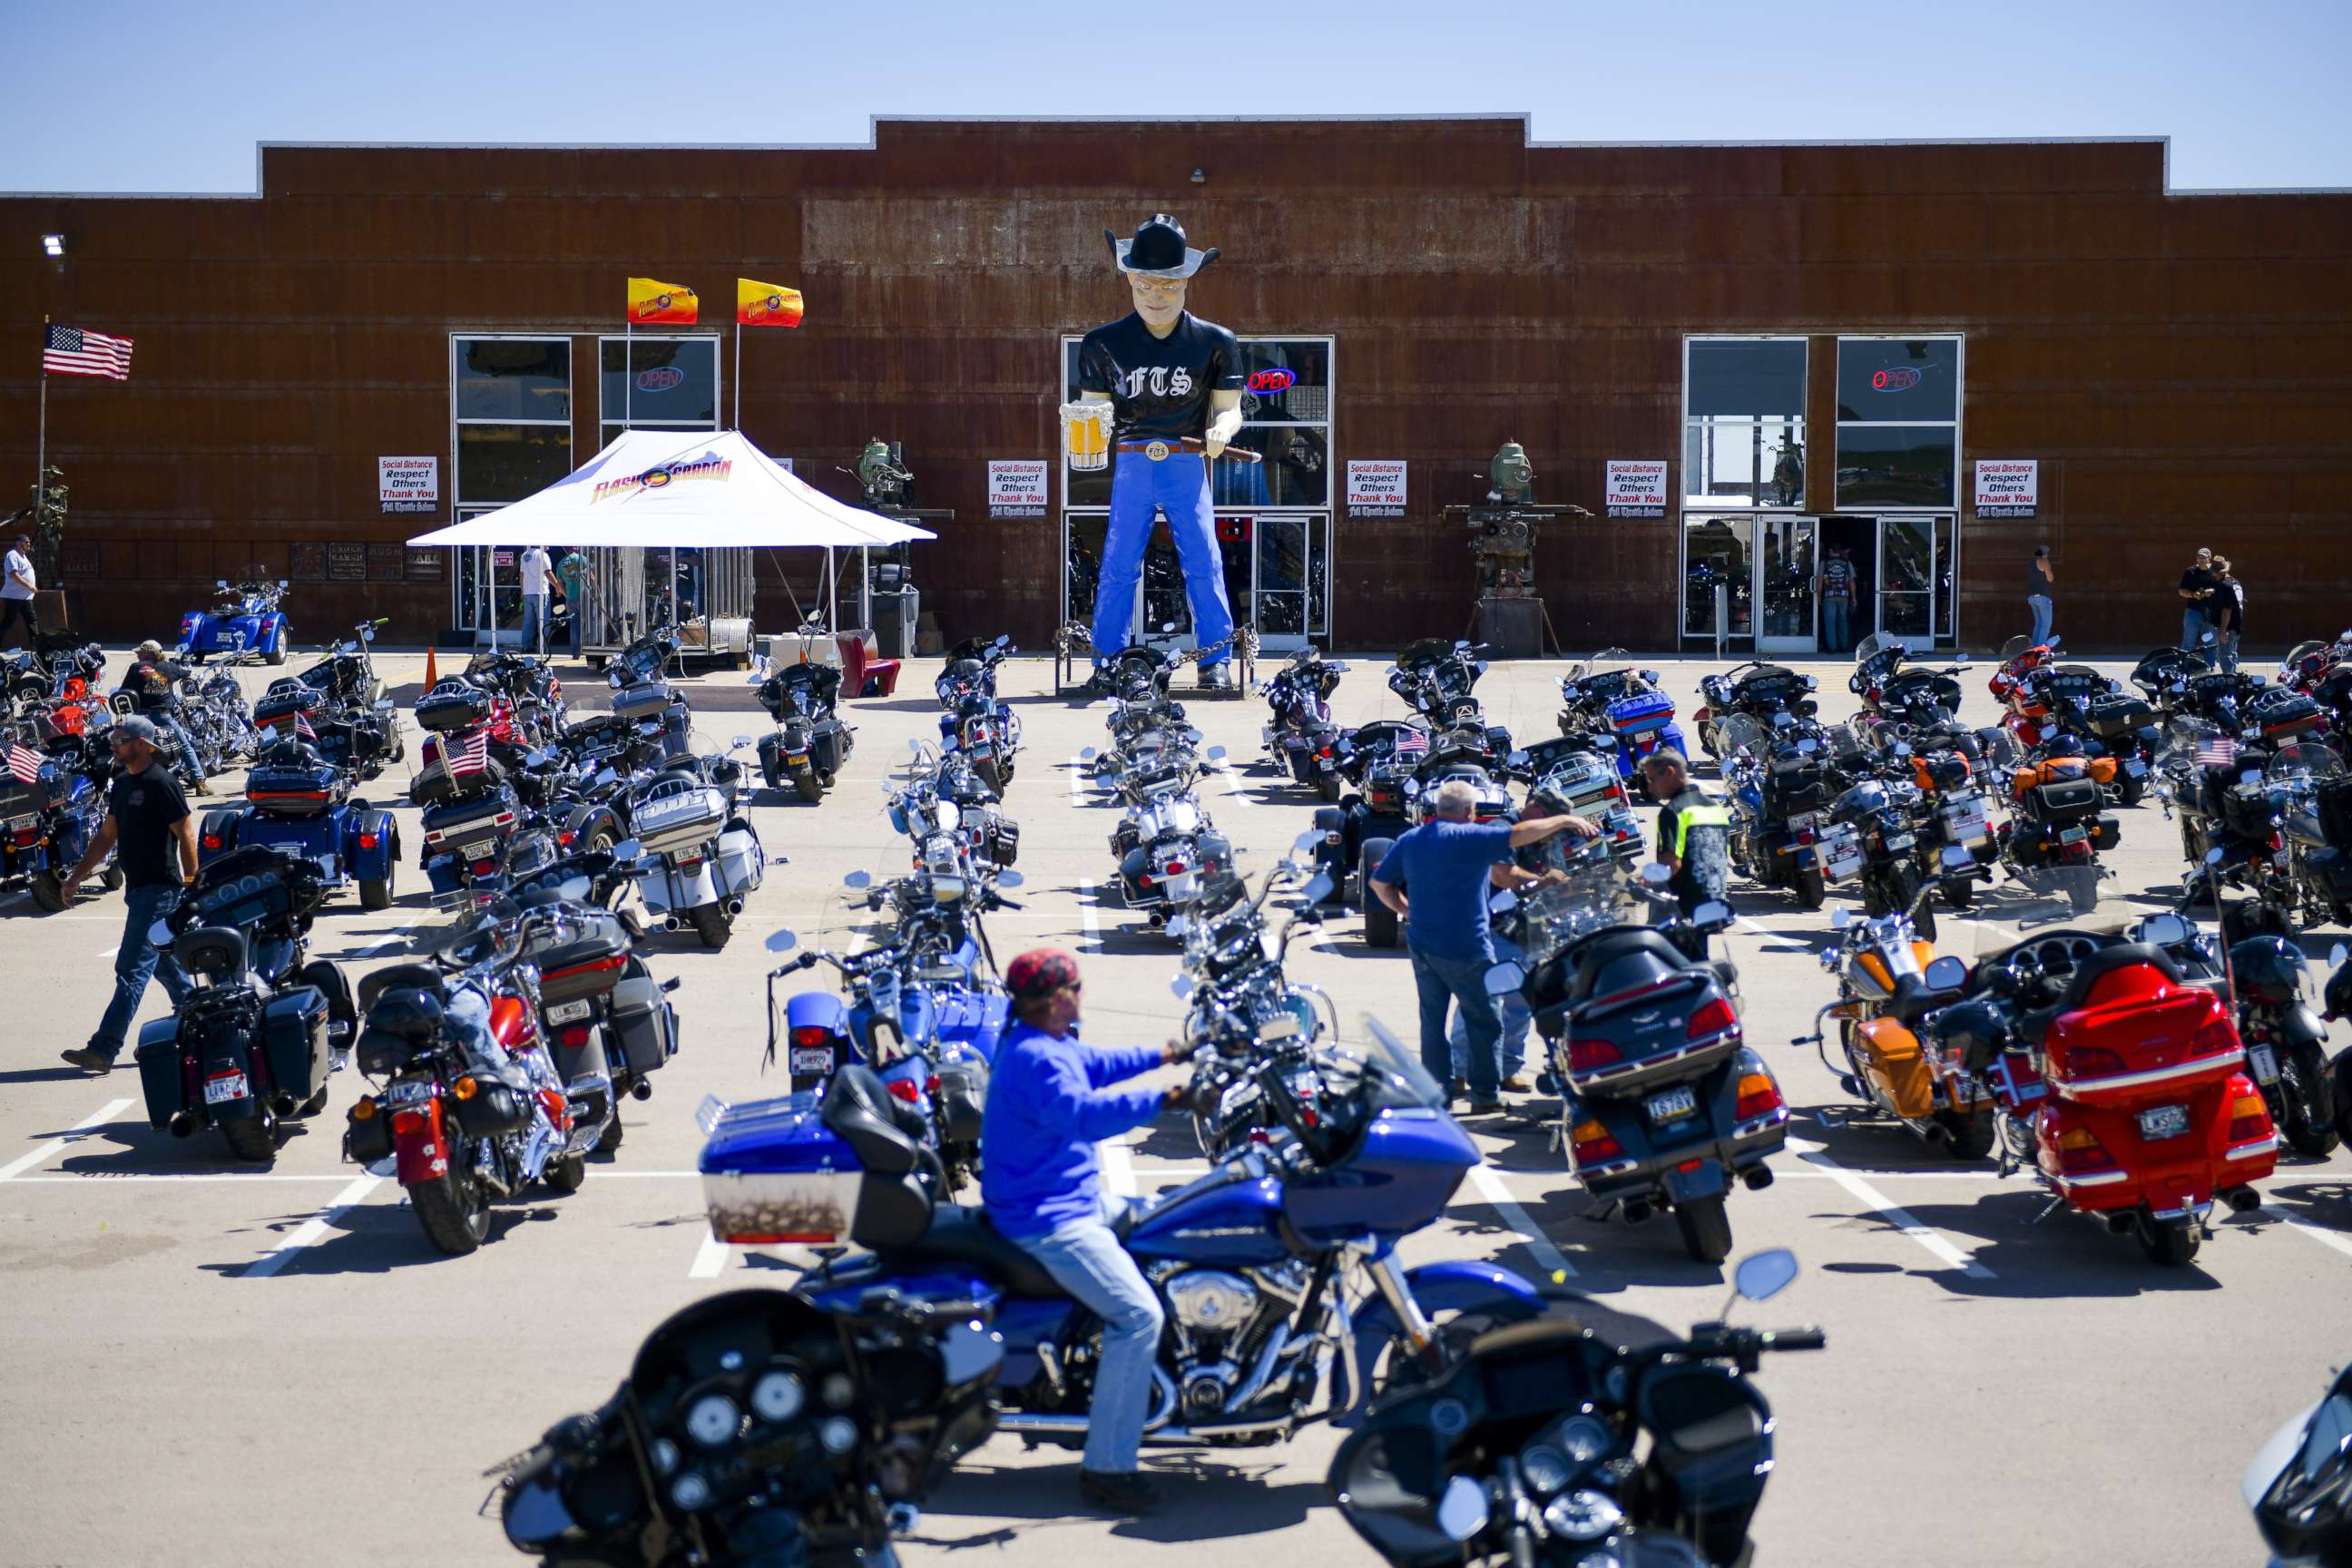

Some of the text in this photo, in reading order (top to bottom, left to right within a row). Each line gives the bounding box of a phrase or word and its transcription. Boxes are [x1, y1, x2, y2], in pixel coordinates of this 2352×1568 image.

[638, 370, 679, 388] OPEN
[1126, 366, 1192, 399] FTS
[1249, 370, 1292, 390] OPEN
[1872, 369, 1917, 389] OPEN
[383, 460, 433, 469] Social Distance
[992, 464, 1043, 472] Social Distance
[1351, 464, 1402, 472] Social Distance
[1610, 464, 1663, 472] Social Distance
[1980, 464, 2033, 472] Social Distance
[387, 470, 429, 480] Respect
[995, 474, 1039, 483] Respect
[1355, 474, 1398, 483] Respect
[1614, 474, 1658, 484] Respect
[1983, 474, 2029, 483] Respect
[392, 480, 426, 488] Others
[591, 459, 733, 505] FLASH GORDON
[1619, 484, 1655, 492] Others
[1989, 484, 2025, 492] Others
[382, 490, 435, 498] Thank You
[991, 494, 1044, 502] Thank You
[1350, 494, 1403, 502] Thank You
[1609, 494, 1663, 503] Thank You
[1978, 494, 2033, 503] Thank You
